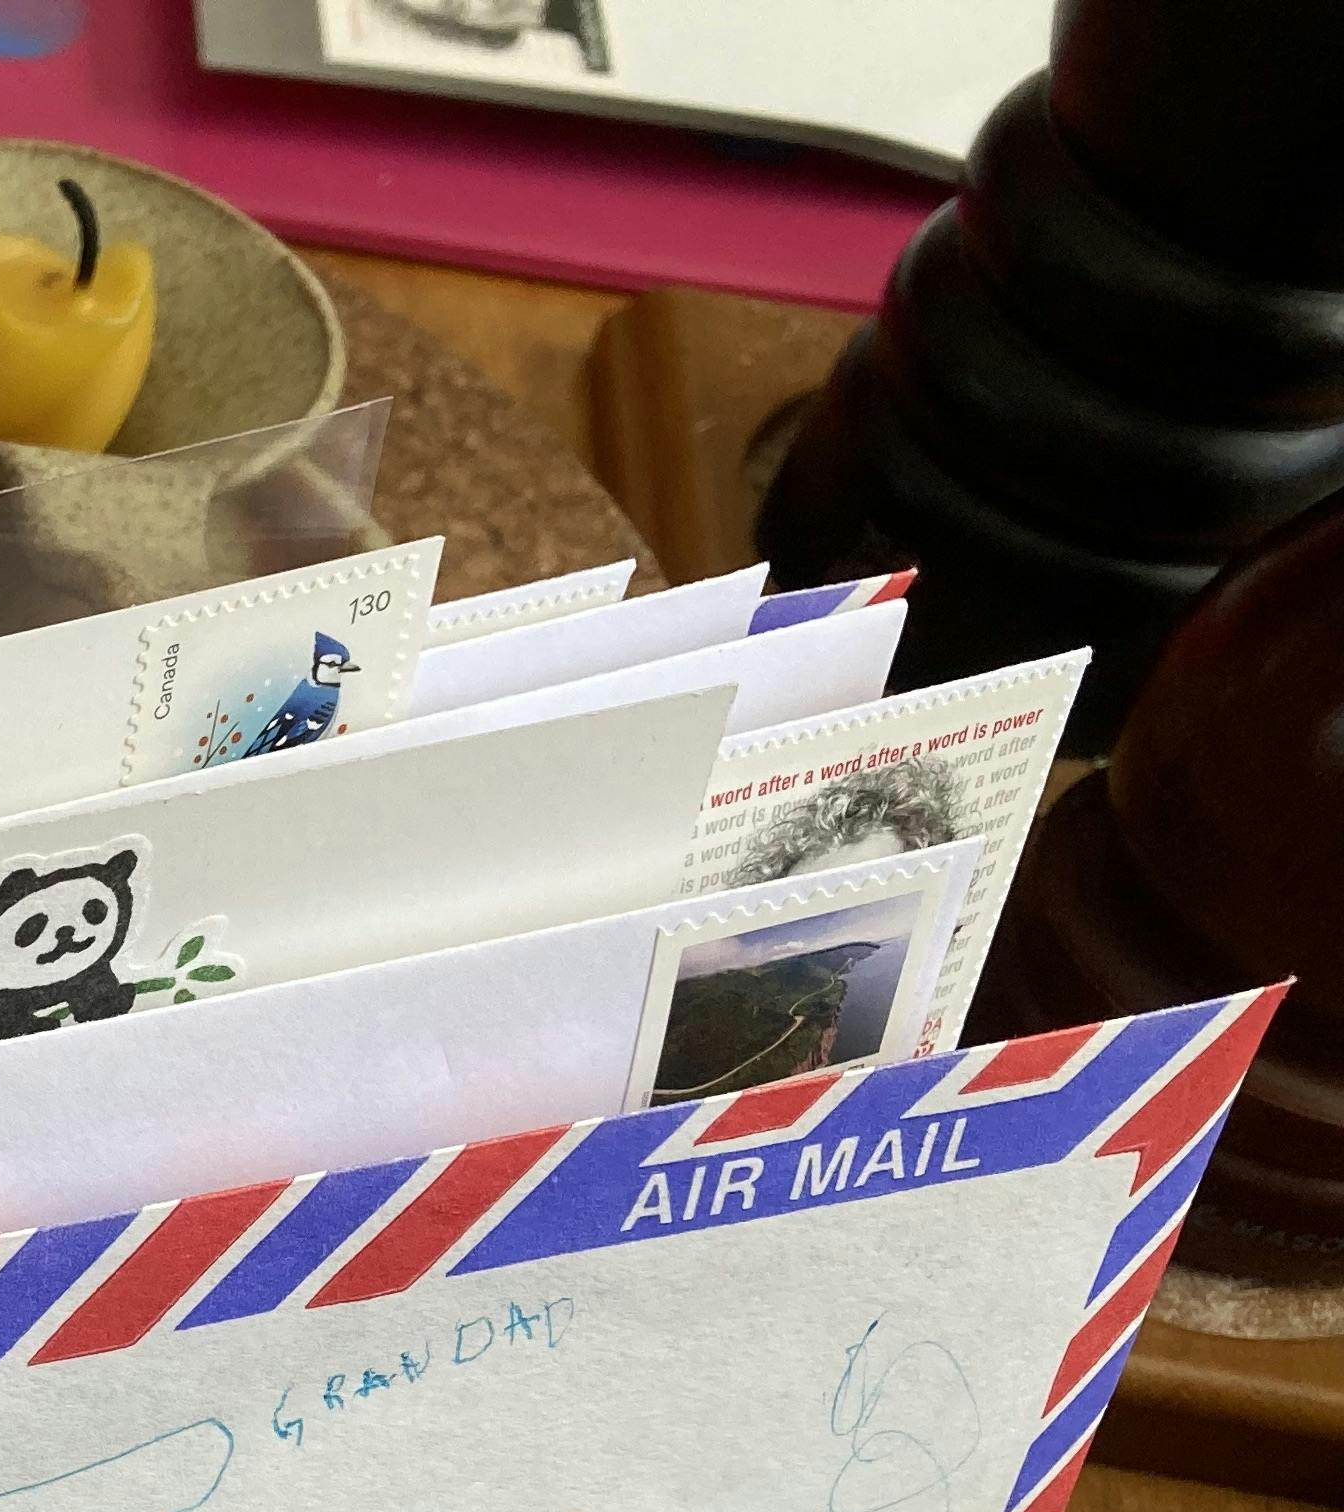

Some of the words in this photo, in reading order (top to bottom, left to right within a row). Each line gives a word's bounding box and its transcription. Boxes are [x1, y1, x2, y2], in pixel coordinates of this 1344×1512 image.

[348, 589, 391, 625] 130
[154, 642, 181, 721] Canada
[711, 782, 753, 809] word
[757, 773, 800, 798] after
[804, 770, 814, 785] a
[820, 754, 863, 781] word
[867, 743, 908, 769] after
[912, 742, 922, 757] a
[928, 725, 969, 751] word
[973, 722, 986, 740] is
[992, 707, 1044, 738] power
[618, 1163, 761, 1233] AIR
[788, 1118, 981, 1204] MAIL
